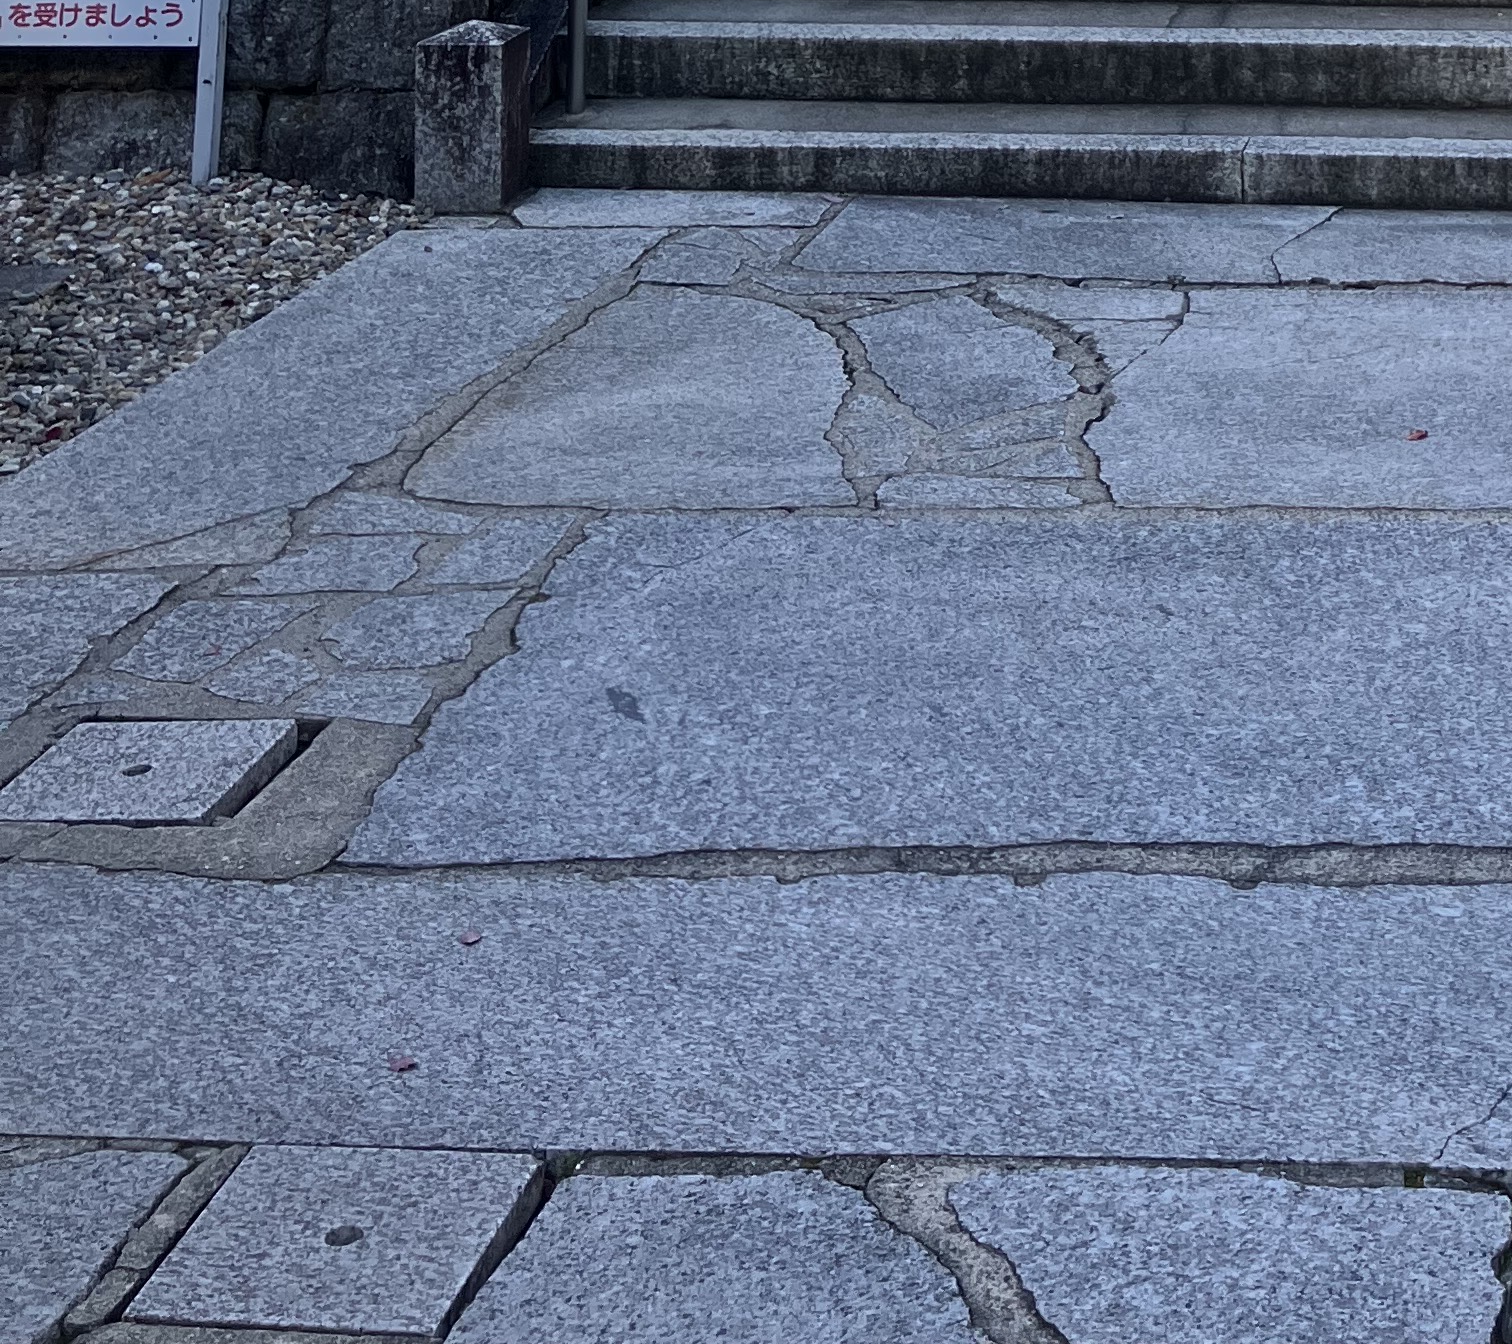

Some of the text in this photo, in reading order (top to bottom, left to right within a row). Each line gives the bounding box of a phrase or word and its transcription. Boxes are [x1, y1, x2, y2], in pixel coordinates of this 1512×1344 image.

[0, 2, 183, 28] を受けましょう
